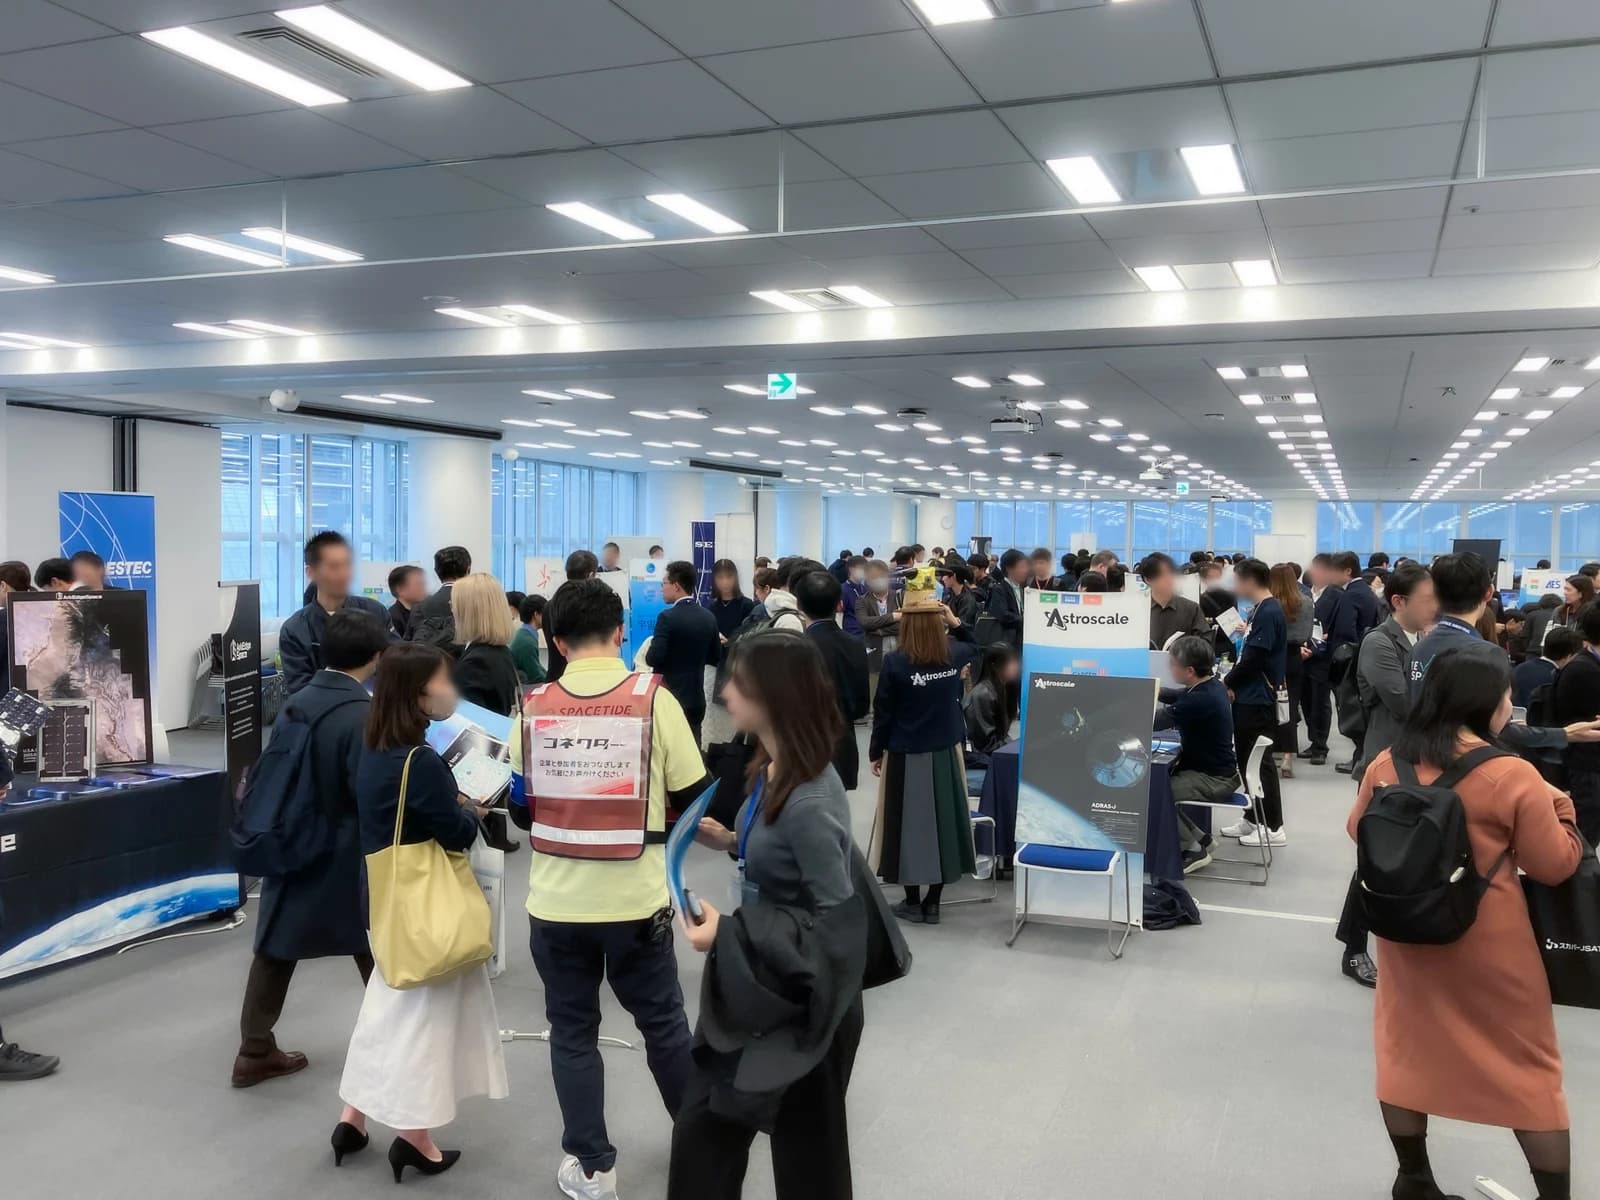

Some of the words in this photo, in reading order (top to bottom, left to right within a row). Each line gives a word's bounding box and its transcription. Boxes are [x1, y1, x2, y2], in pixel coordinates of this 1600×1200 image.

[105, 561, 152, 575] ESTEC
[1044, 608, 1129, 631] Astroscale
[910, 668, 957, 686] Astroscale
[1034, 678, 1076, 689] Astroscale
[560, 705, 632, 716] SPACETIDE
[544, 738, 625, 749] コネクター
